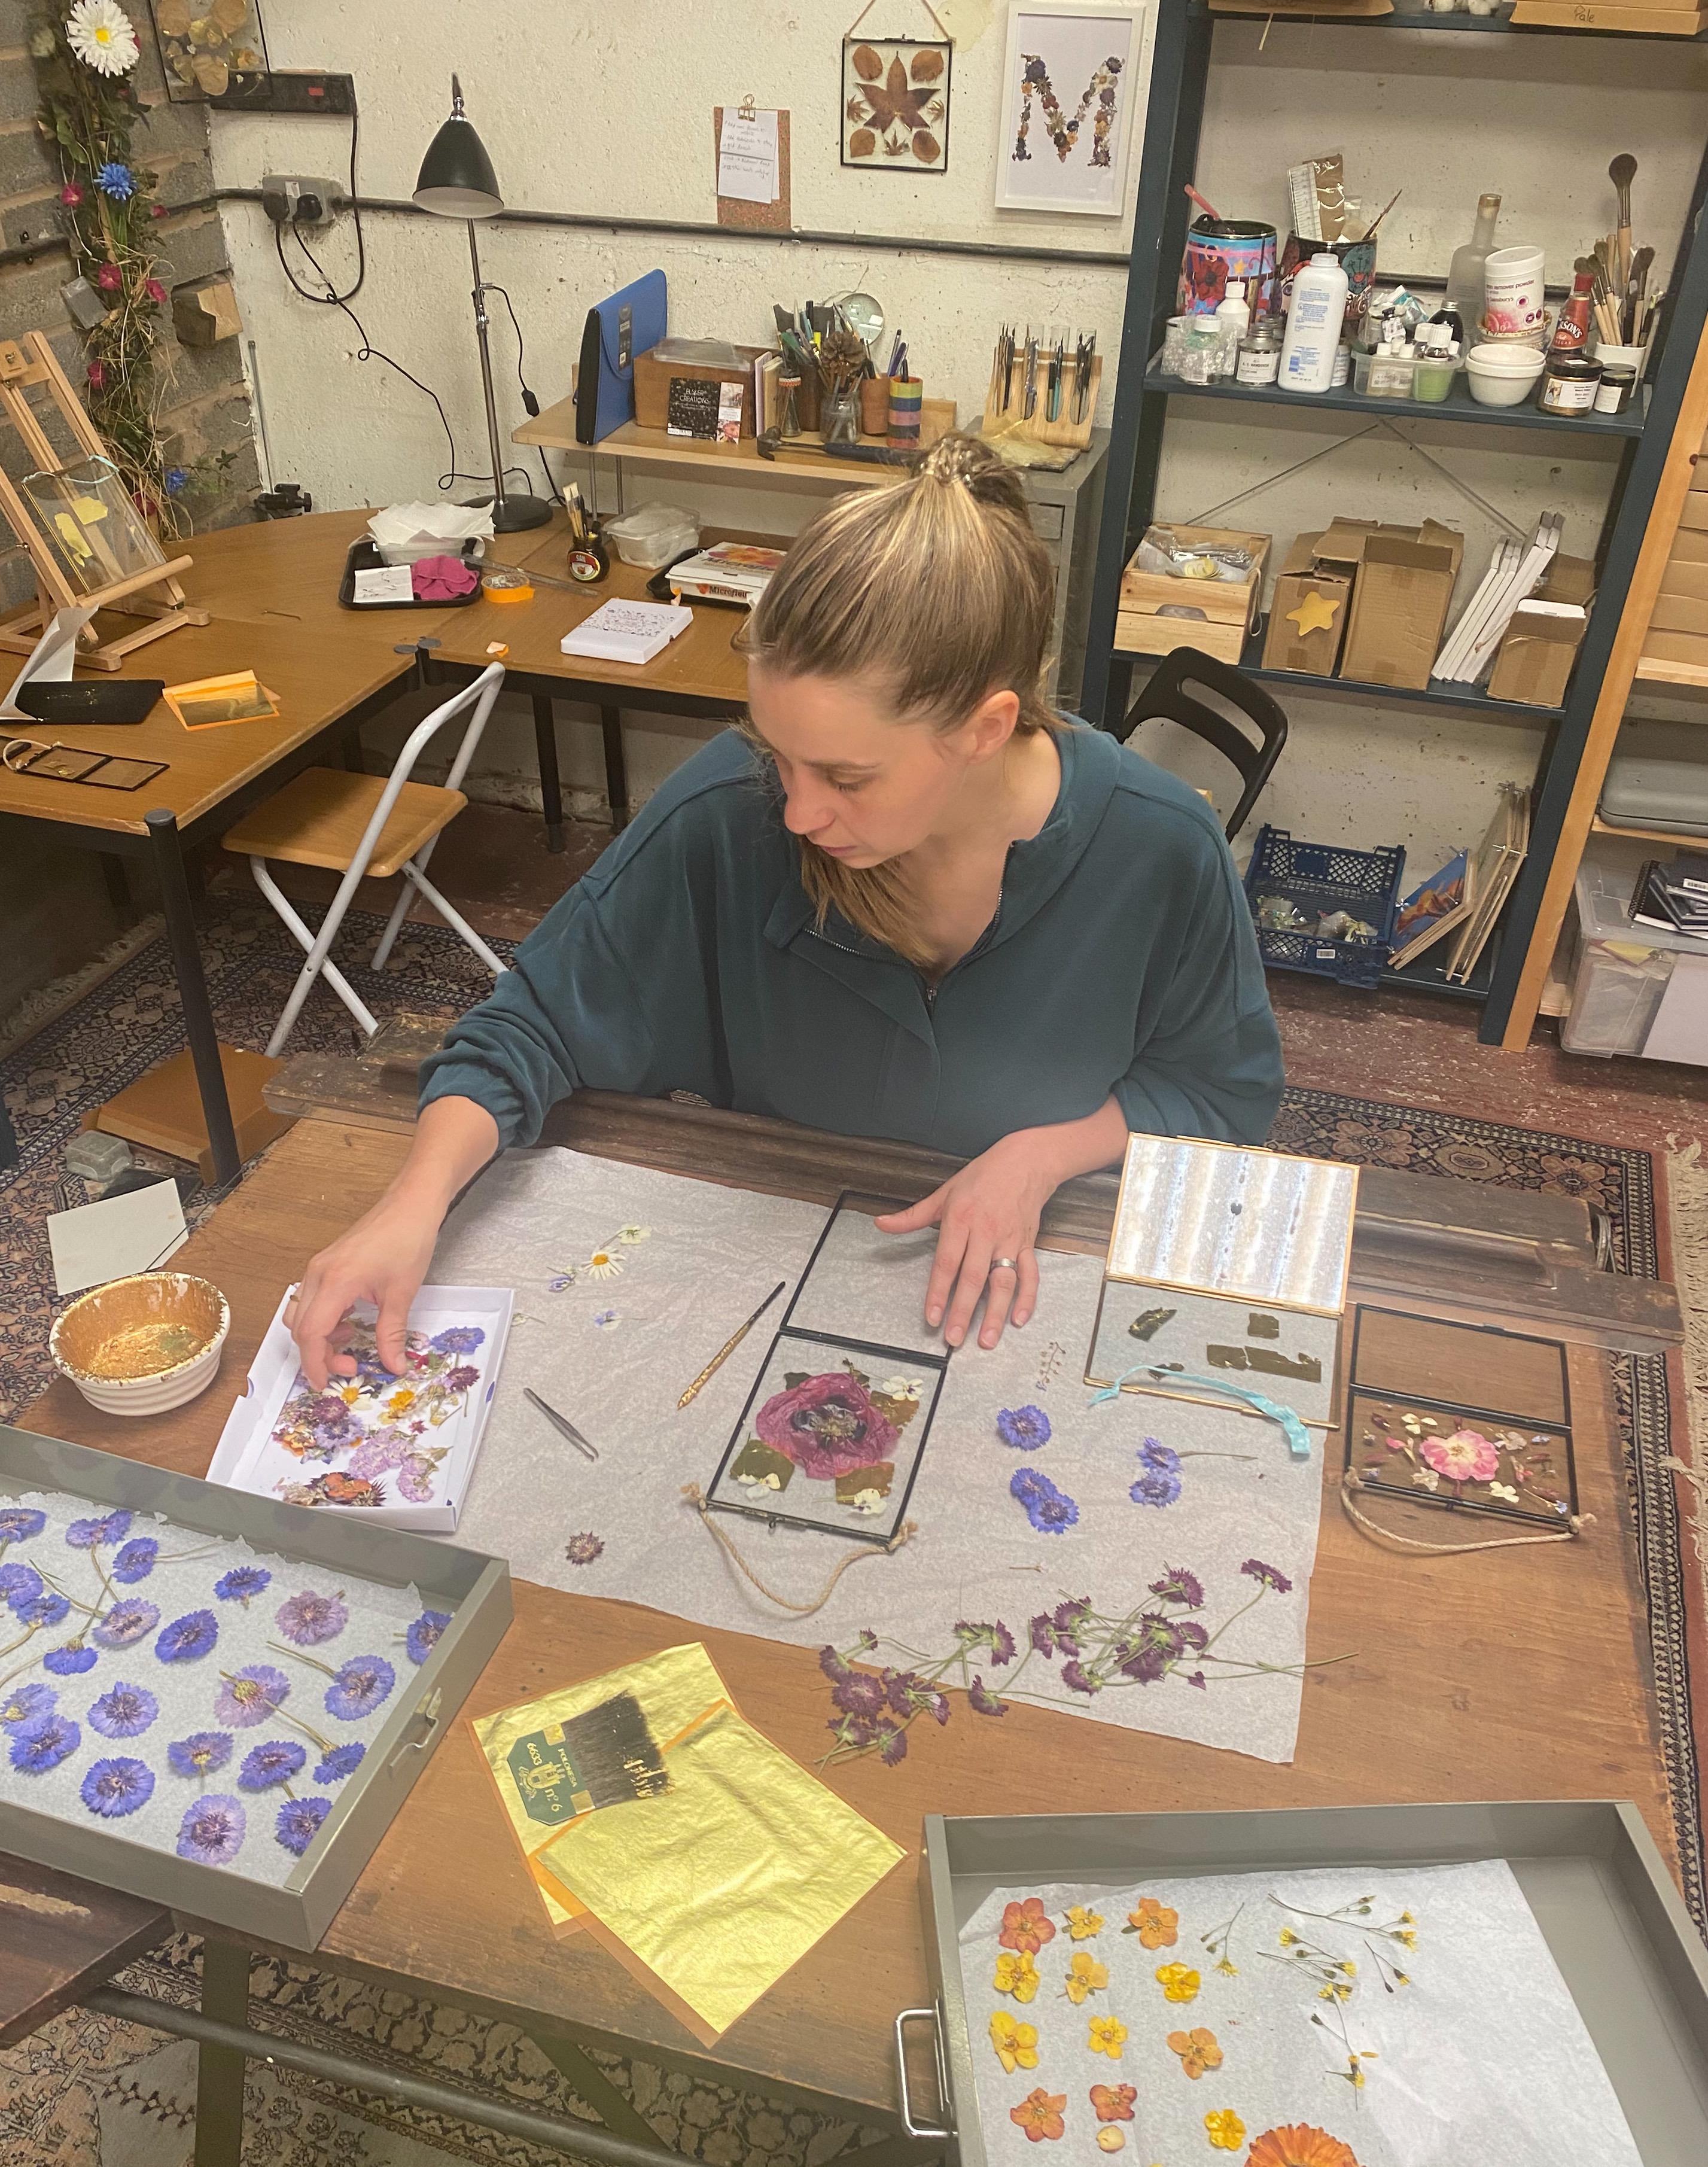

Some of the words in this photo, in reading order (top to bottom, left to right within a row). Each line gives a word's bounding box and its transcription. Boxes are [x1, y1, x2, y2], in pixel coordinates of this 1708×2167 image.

[1574, 5, 1595, 23] Pale
[709, 585, 747, 598] Microfleu
[527, 1743, 542, 1765] 6633
[558, 1748, 577, 1787] POLONESA
[551, 1803, 563, 1812] 6
